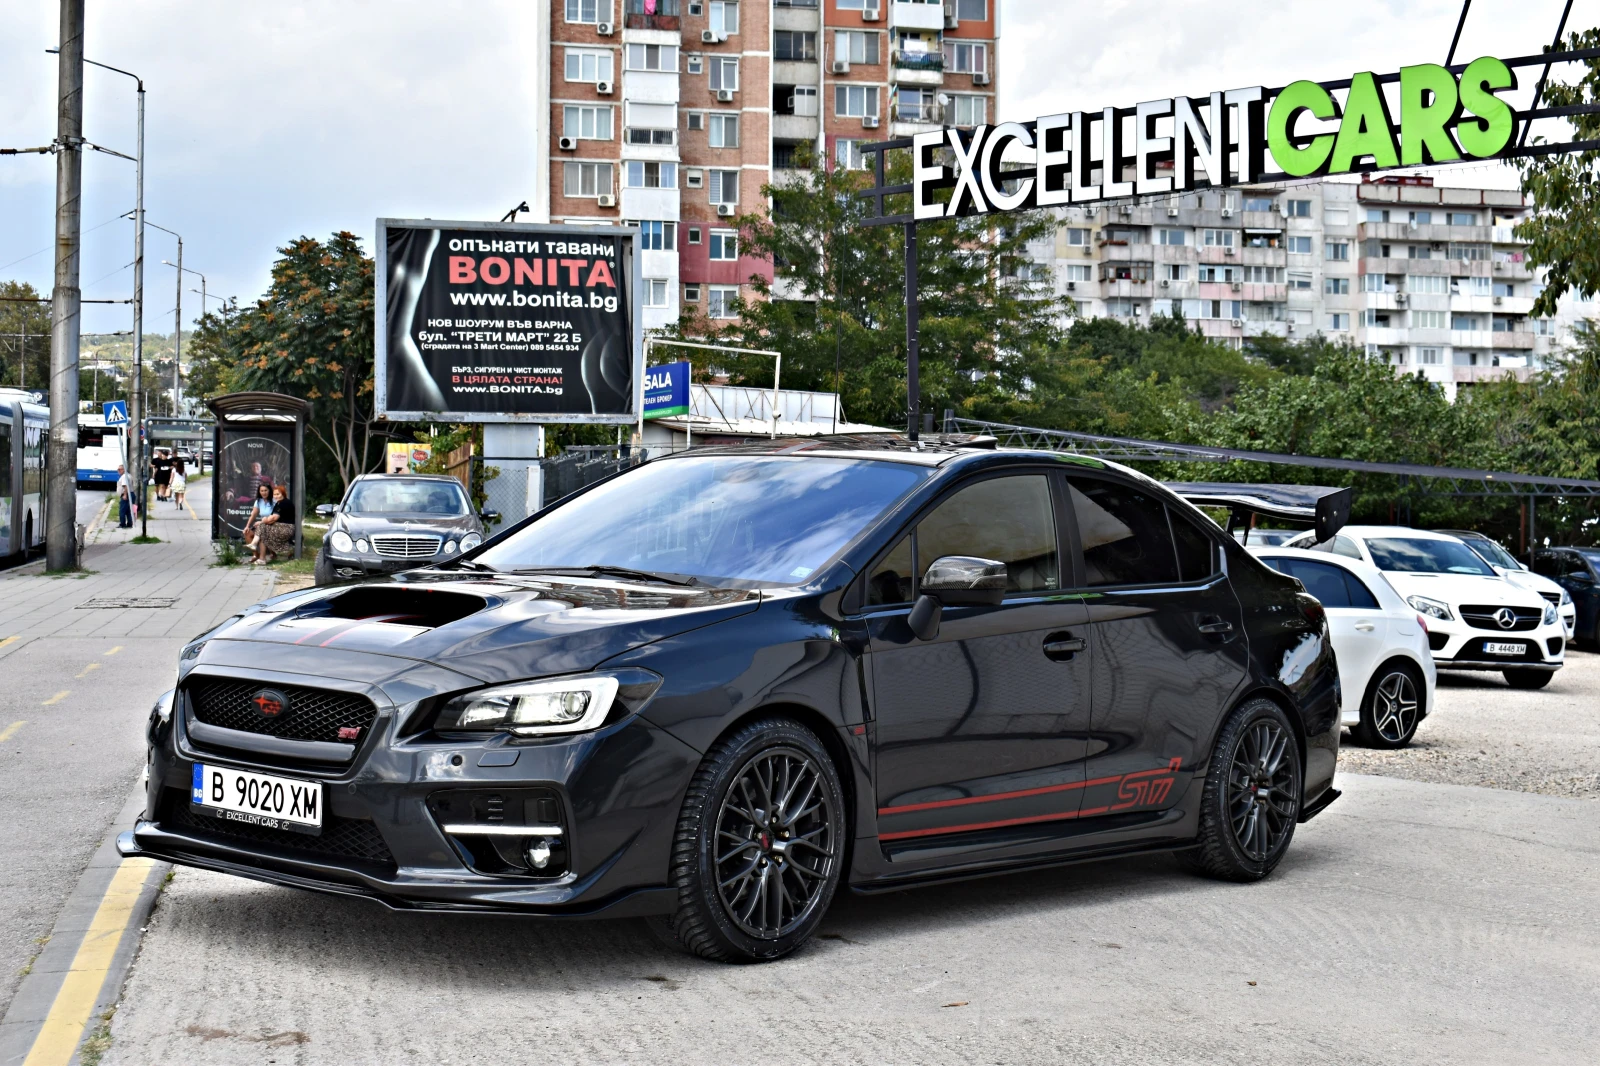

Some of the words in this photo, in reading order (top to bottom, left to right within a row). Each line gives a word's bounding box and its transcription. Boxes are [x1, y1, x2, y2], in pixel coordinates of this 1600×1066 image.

[448, 238, 540, 254] опънати
[545, 241, 615, 257] тавани
[448, 256, 616, 288] BONITA
[450, 290, 618, 313] www.bonita.bg
[427, 319, 452, 327] НОВ
[455, 319, 504, 329] ШОУРУМ
[507, 320, 532, 329] ВЪВ
[535, 321, 573, 330] ВАРНА
[418, 331, 447, 342] бул.
[553, 333, 568, 343] 22
[572, 333, 582, 343] Б
[421, 343, 460, 351] (сградата
[499, 343, 529, 351] Center)
[451, 366, 473, 374] БЪРЗ,
[474, 366, 506, 374] СИГУРЕН
[533, 367, 563, 375] МОНТАЖ
[452, 375, 460, 383] В
[463, 375, 511, 385] ЦЯЛАТА
[513, 376, 563, 385] СТРАНА!
[452, 385, 563, 396] www.BONITA.bg
[193, 787, 203, 798] BG
[212, 771, 224, 802] B
[236, 776, 284, 813] 9020
[289, 784, 318, 820] XM
[226, 811, 262, 825] EXCELLENT
[261, 817, 279, 829] CARS
